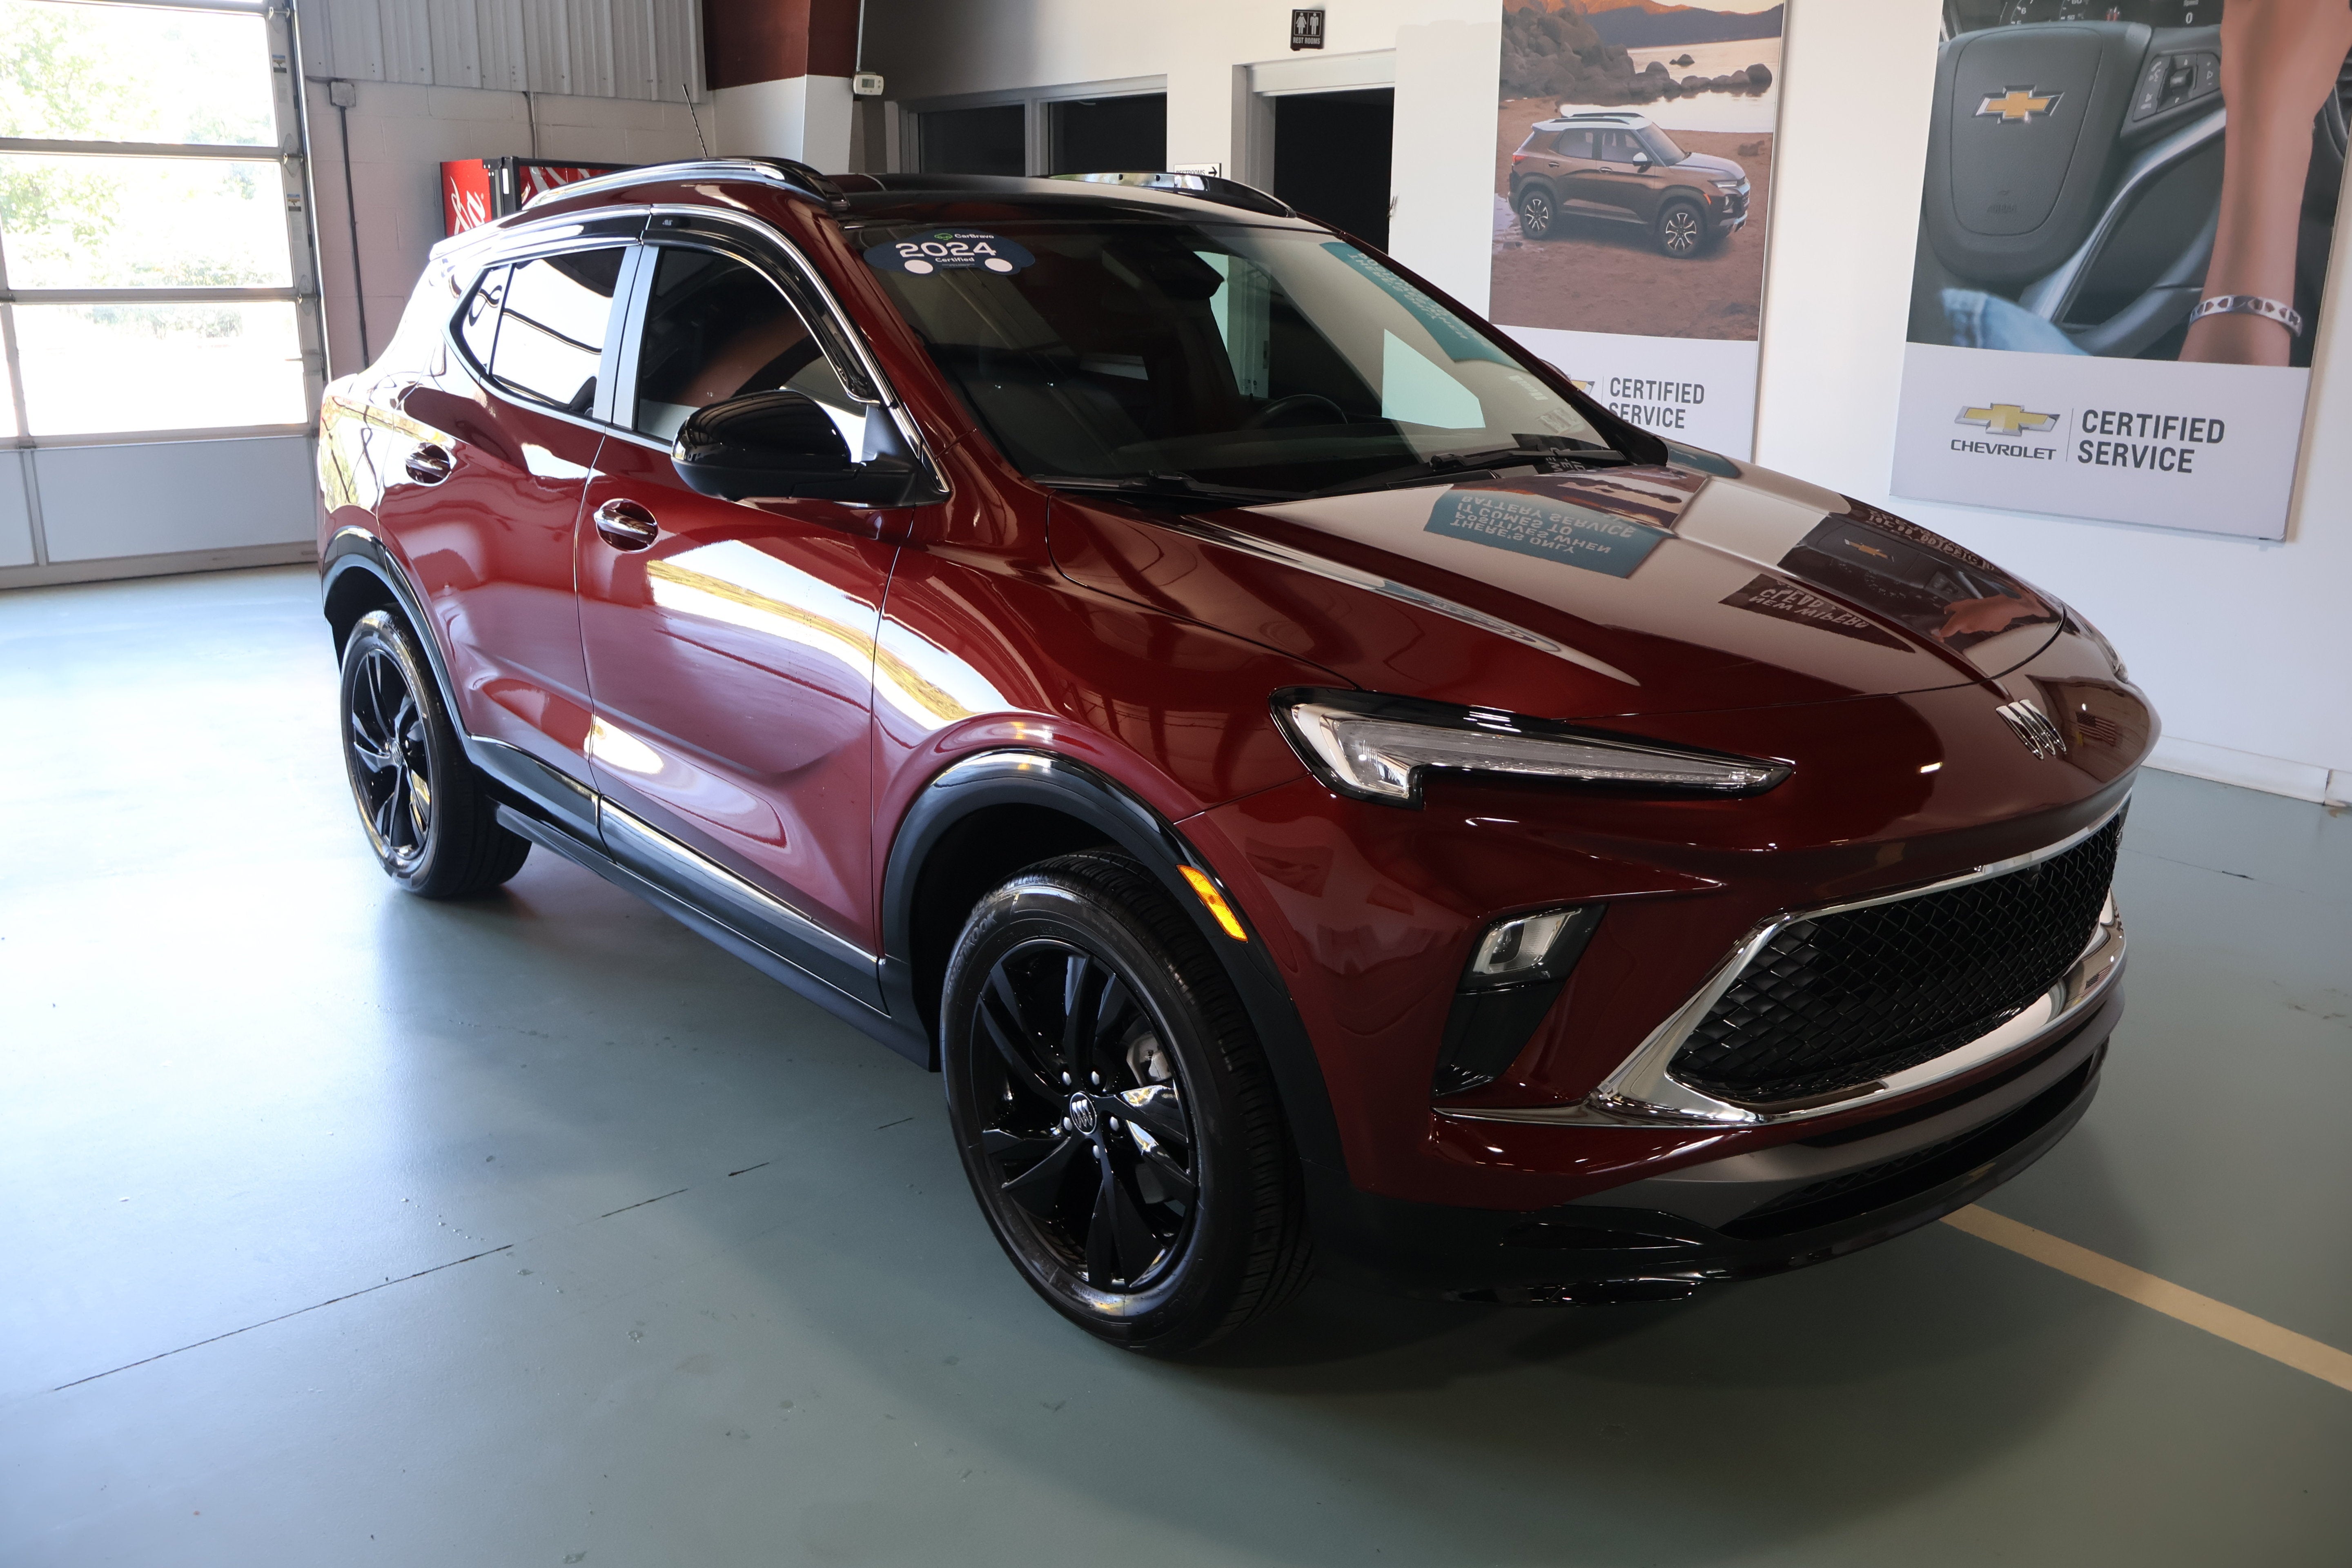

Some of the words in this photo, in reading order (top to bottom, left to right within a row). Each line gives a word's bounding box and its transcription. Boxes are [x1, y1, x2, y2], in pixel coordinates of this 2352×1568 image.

[895, 242, 997, 258] 2024
[1610, 377, 1705, 404] CERTIFIED
[2081, 409, 2225, 444] CERTIFIED
[1950, 439, 2056, 461] CHEVROLET
[2077, 439, 2195, 473] SERVICE
